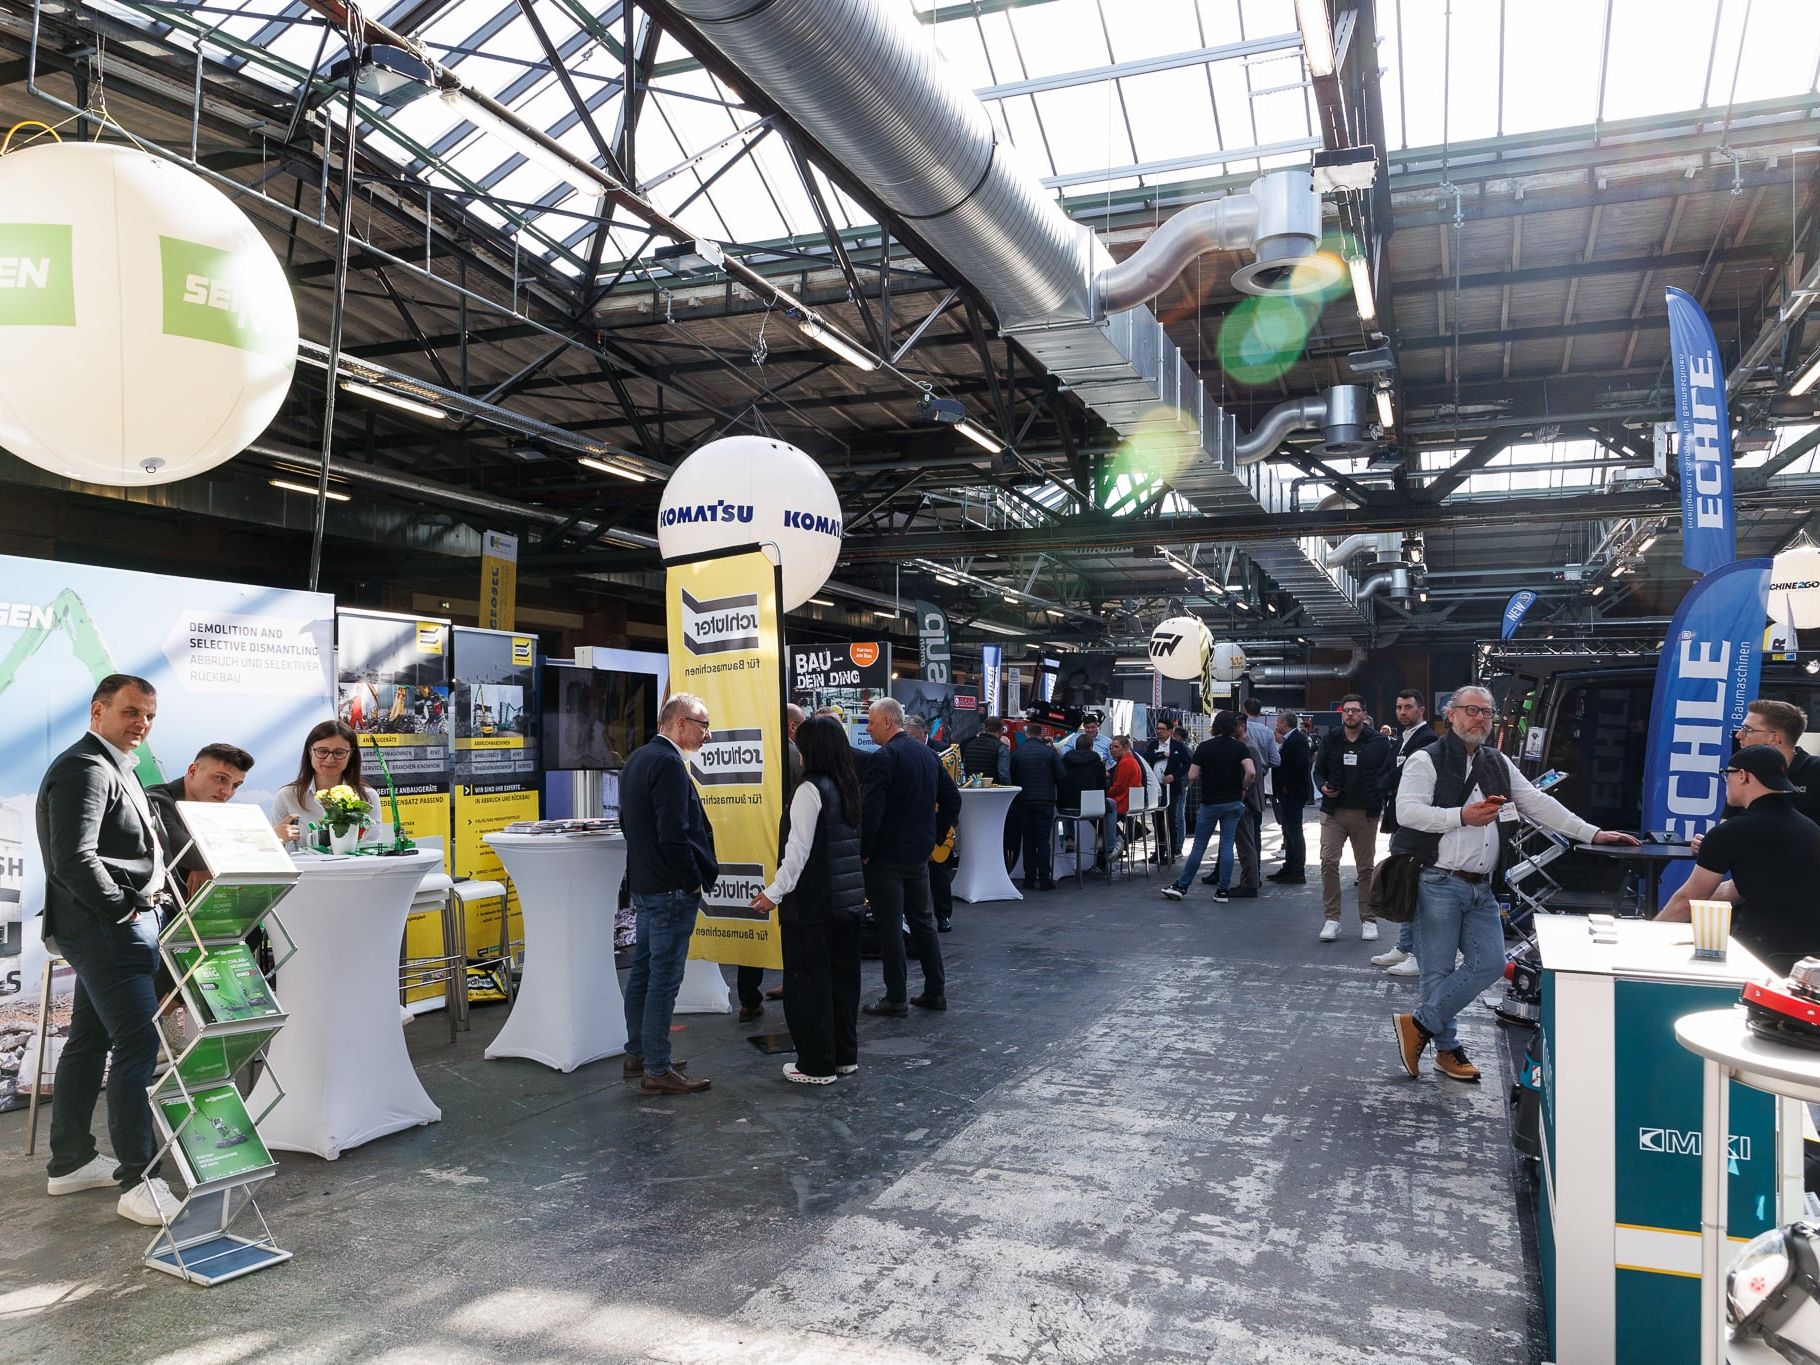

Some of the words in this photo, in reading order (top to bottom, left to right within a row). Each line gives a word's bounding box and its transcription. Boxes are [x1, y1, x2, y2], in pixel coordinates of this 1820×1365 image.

[660, 500, 754, 528] KOMATSU
[1506, 601, 1526, 622] NEW
[190, 622, 257, 637] DEMOLITION
[261, 628, 283, 639] AND
[189, 638, 248, 652] SELECTIVE
[249, 643, 318, 656] DISMANTLING
[190, 654, 239, 667] ABBRUCH
[241, 658, 262, 668] UND
[264, 659, 320, 671] SELEKTIVER
[797, 672, 825, 689] DEIN
[829, 670, 861, 686] DING
[1731, 641, 1750, 720] Baumaschinen
[399, 785, 437, 794] ANBAUGERÄTE
